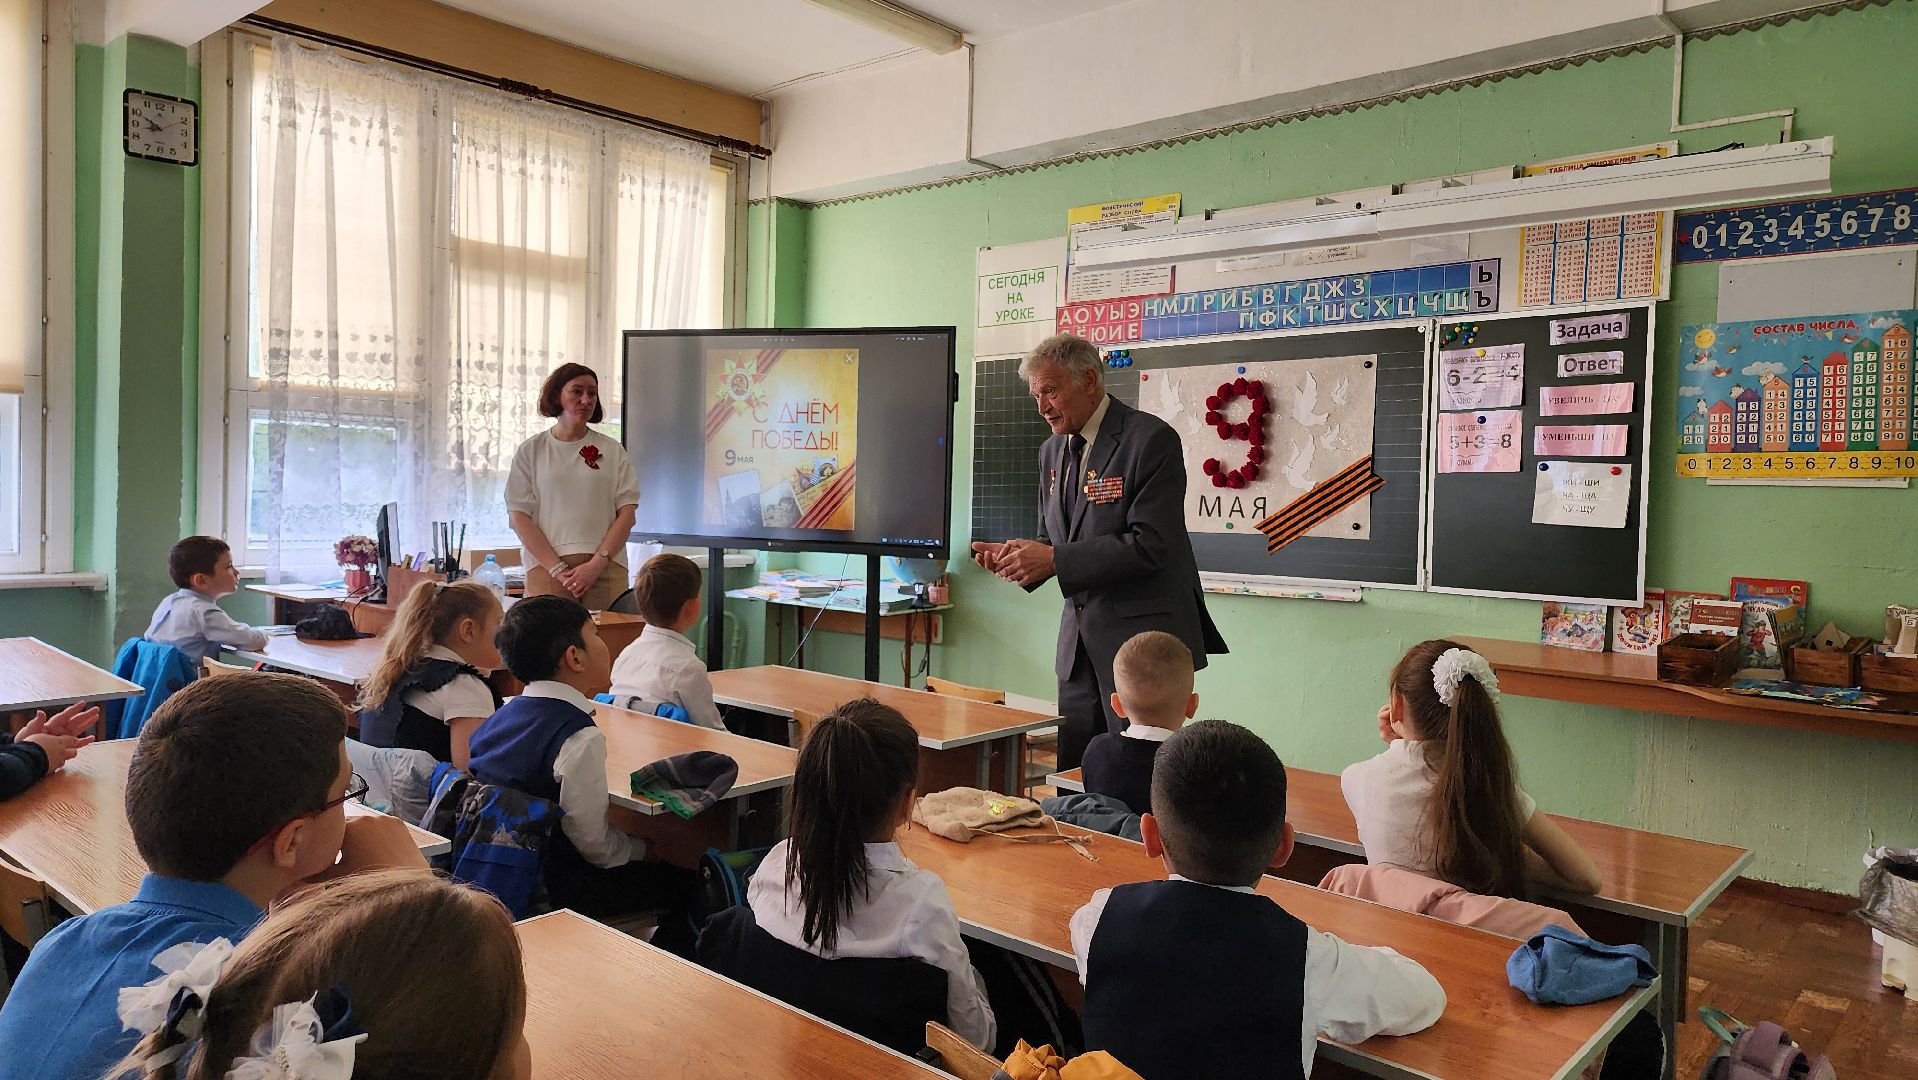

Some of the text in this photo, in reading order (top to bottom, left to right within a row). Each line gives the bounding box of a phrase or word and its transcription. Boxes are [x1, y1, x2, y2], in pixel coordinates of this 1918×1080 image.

[1548, 164, 1584, 174] ТАБЛИЦА
[1692, 205, 1910, 249] 0 1 2 3 4 5 6 7 8
[988, 270, 1044, 289] СЕГОДНЯ
[1008, 292, 1024, 304] НА
[996, 307, 1034, 322] УРОКЕ
[1556, 321, 1622, 339] Задача
[1754, 319, 1855, 335] СОСТАВ ЧИСЛА
[1564, 358, 1618, 372] Ответ
[1548, 396, 1594, 404] УВЕЛИЧЬ
[753, 398, 839, 424] С ДНЁМ
[752, 430, 838, 450] ПОБЕДЫ!
[1202, 378, 1270, 489] 9
[725, 450, 736, 466] 9
[1688, 457, 1914, 469] 0 1 2 3 4 5 6 7 8 9 10
[1199, 495, 1267, 519] МАЯ
[1580, 506, 1595, 514] ЩУ
